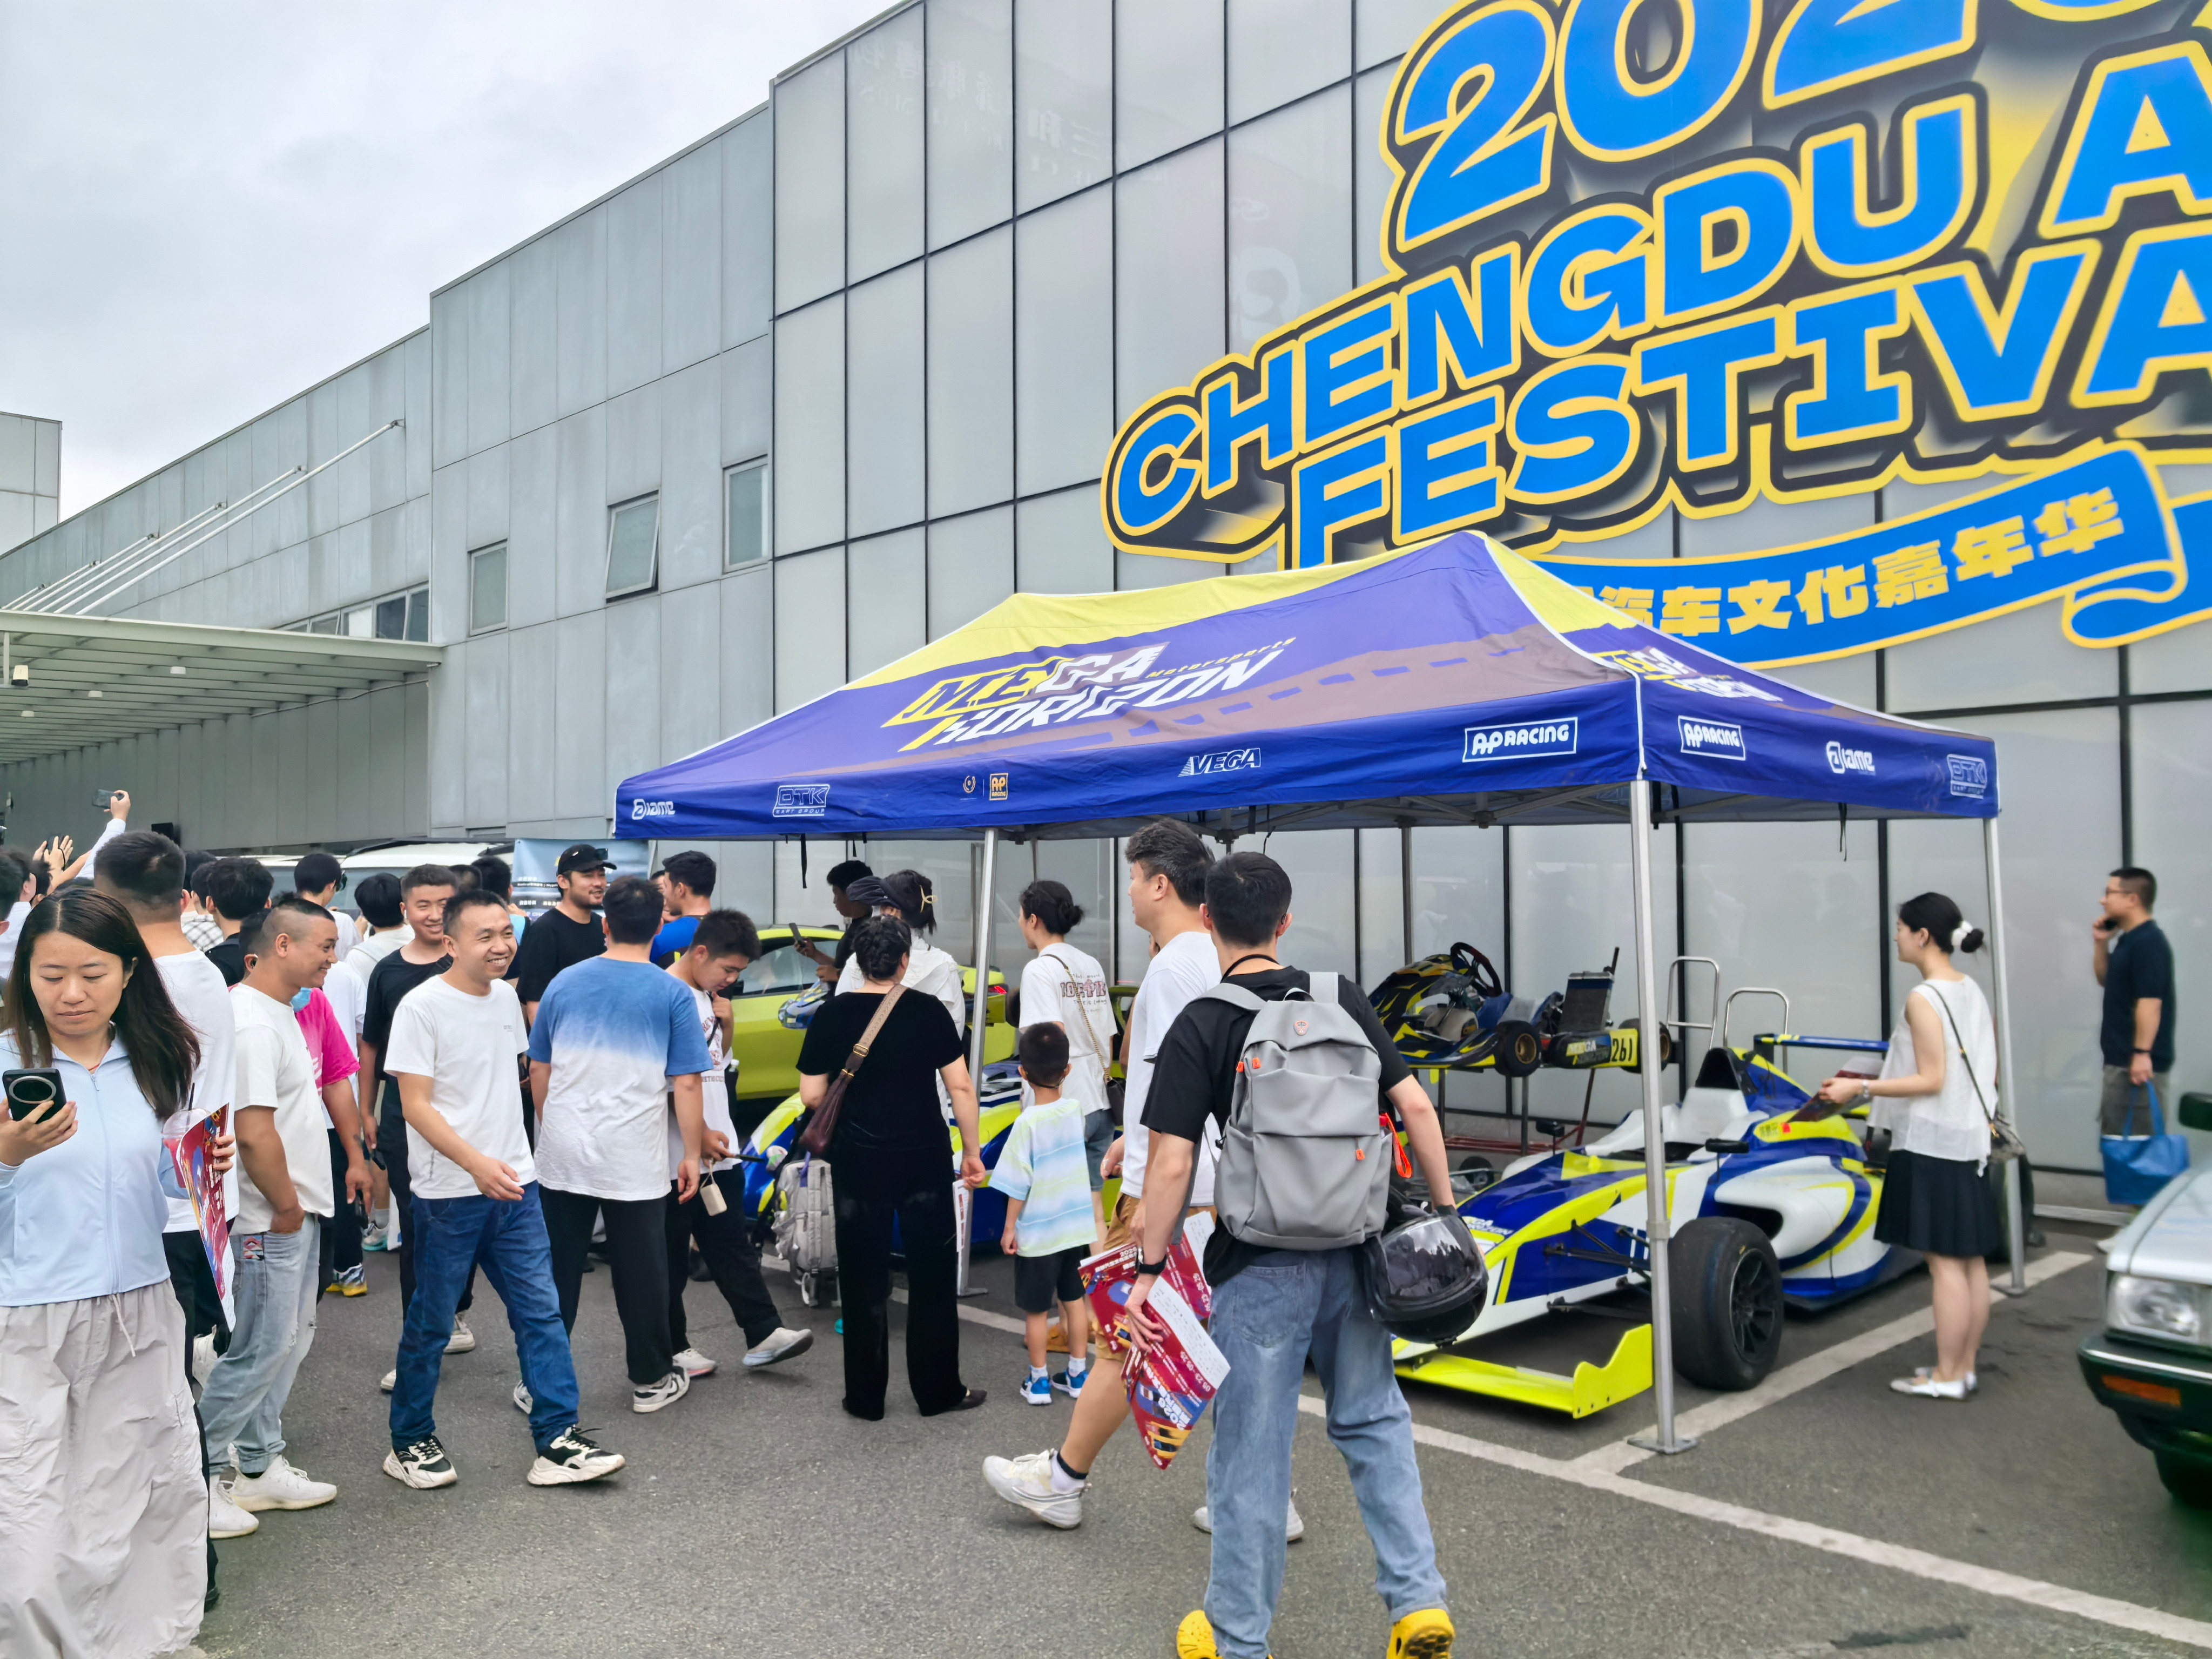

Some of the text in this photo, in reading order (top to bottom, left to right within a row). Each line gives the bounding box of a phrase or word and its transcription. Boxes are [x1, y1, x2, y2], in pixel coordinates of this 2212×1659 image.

[1114, 93, 1977, 534] CHENGDU
[1582, 488, 2128, 638] 汽车文化嘉年华
[881, 644, 1163, 727] MEGA
[898, 650, 1284, 751] HORIZON
[778, 787, 828, 806] OTK
[1188, 748, 1262, 775] VEGA
[1611, 1037, 1633, 1062] 261
